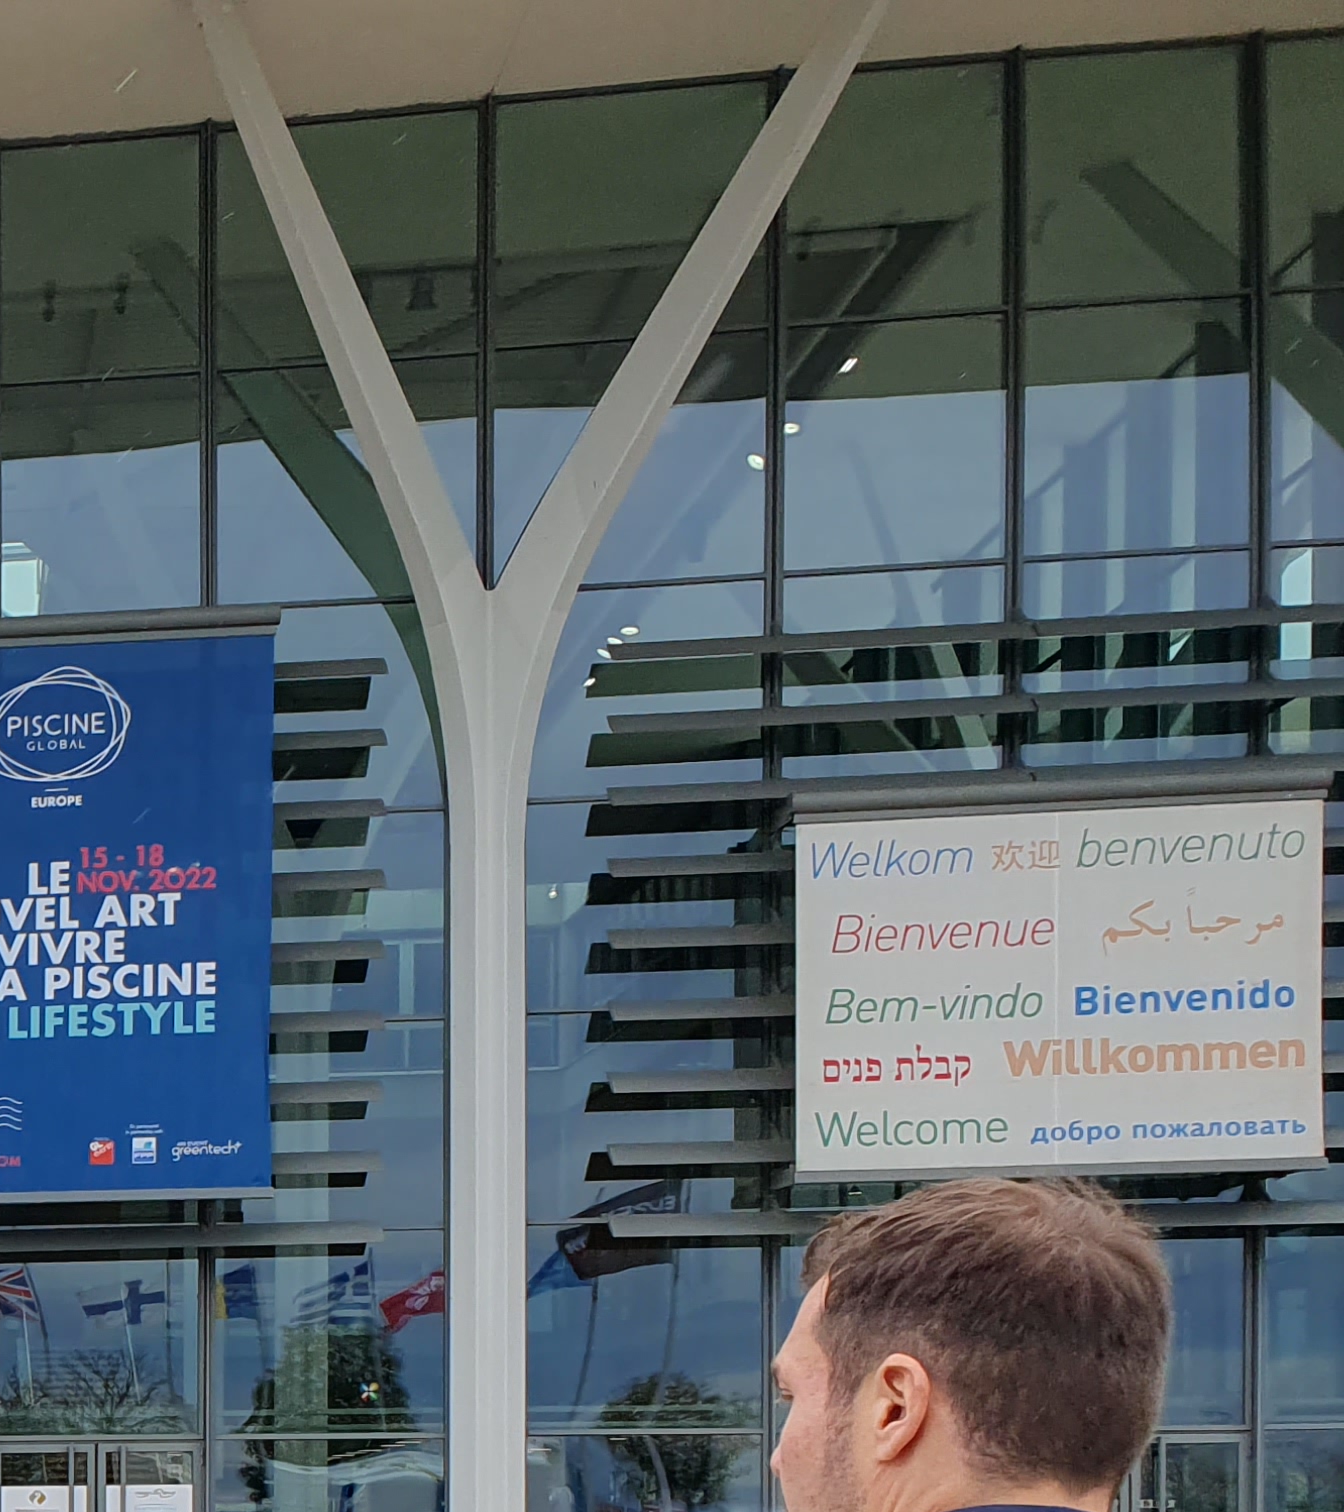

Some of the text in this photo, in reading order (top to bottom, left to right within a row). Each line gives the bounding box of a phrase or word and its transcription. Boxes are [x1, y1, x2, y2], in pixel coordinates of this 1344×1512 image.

[6, 711, 106, 738] PISCINE
[26, 738, 86, 752] GLOBAL
[30, 794, 83, 809] EUROPE
[79, 846, 107, 869] 15
[135, 844, 164, 866] 18
[810, 840, 973, 879] Welkom
[990, 838, 1061, 872] 欢迎
[1075, 823, 1306, 870] benvenuto
[28, 861, 70, 896] LE
[77, 866, 217, 893] NOV. 2022
[94, 892, 181, 929] ART
[831, 914, 1055, 955] Bienvenue
[44, 962, 217, 1001] PISCINE
[1074, 979, 1295, 1016] Bienvenido
[8, 1001, 216, 1040] LIFESTYLE
[825, 983, 1044, 1025] Bem-vindo
[822, 1045, 972, 1087] קבלת פנים
[1002, 1037, 1306, 1078] Willkommen
[814, 1110, 1009, 1148] Welcome
[1030, 1119, 1306, 1145] добро пожаловать
